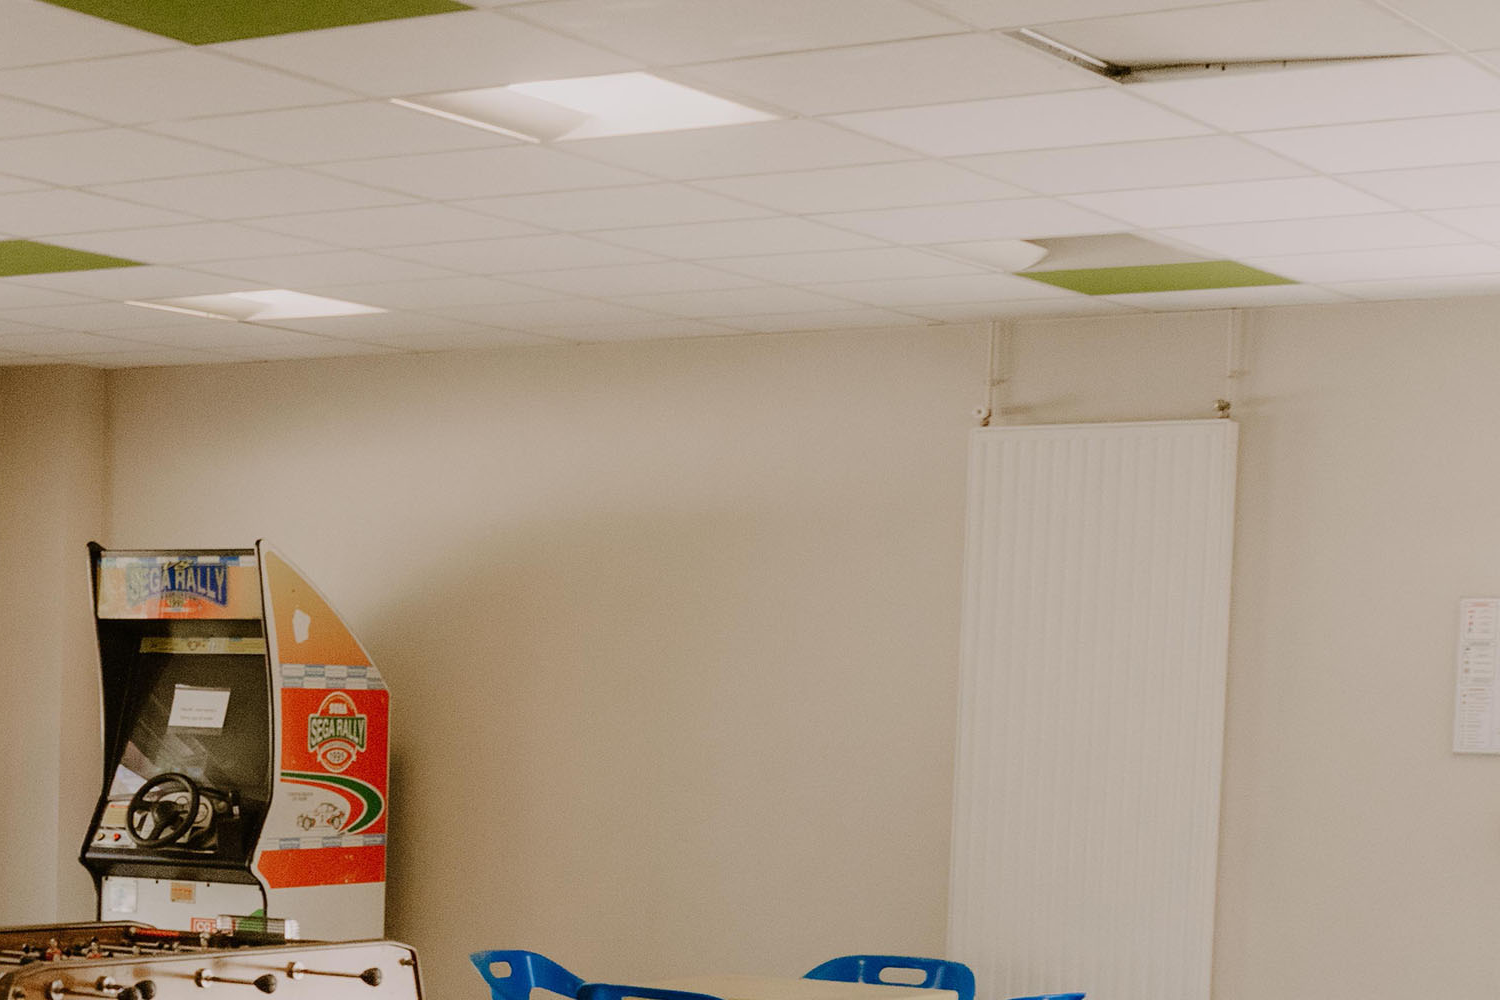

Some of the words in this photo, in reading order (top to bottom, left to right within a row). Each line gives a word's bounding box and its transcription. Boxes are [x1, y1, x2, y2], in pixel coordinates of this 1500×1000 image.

[129, 566, 172, 601] SEGA
[174, 565, 226, 604] RALLY
[310, 718, 336, 747] SEGA
[336, 718, 366, 747] RALLY
